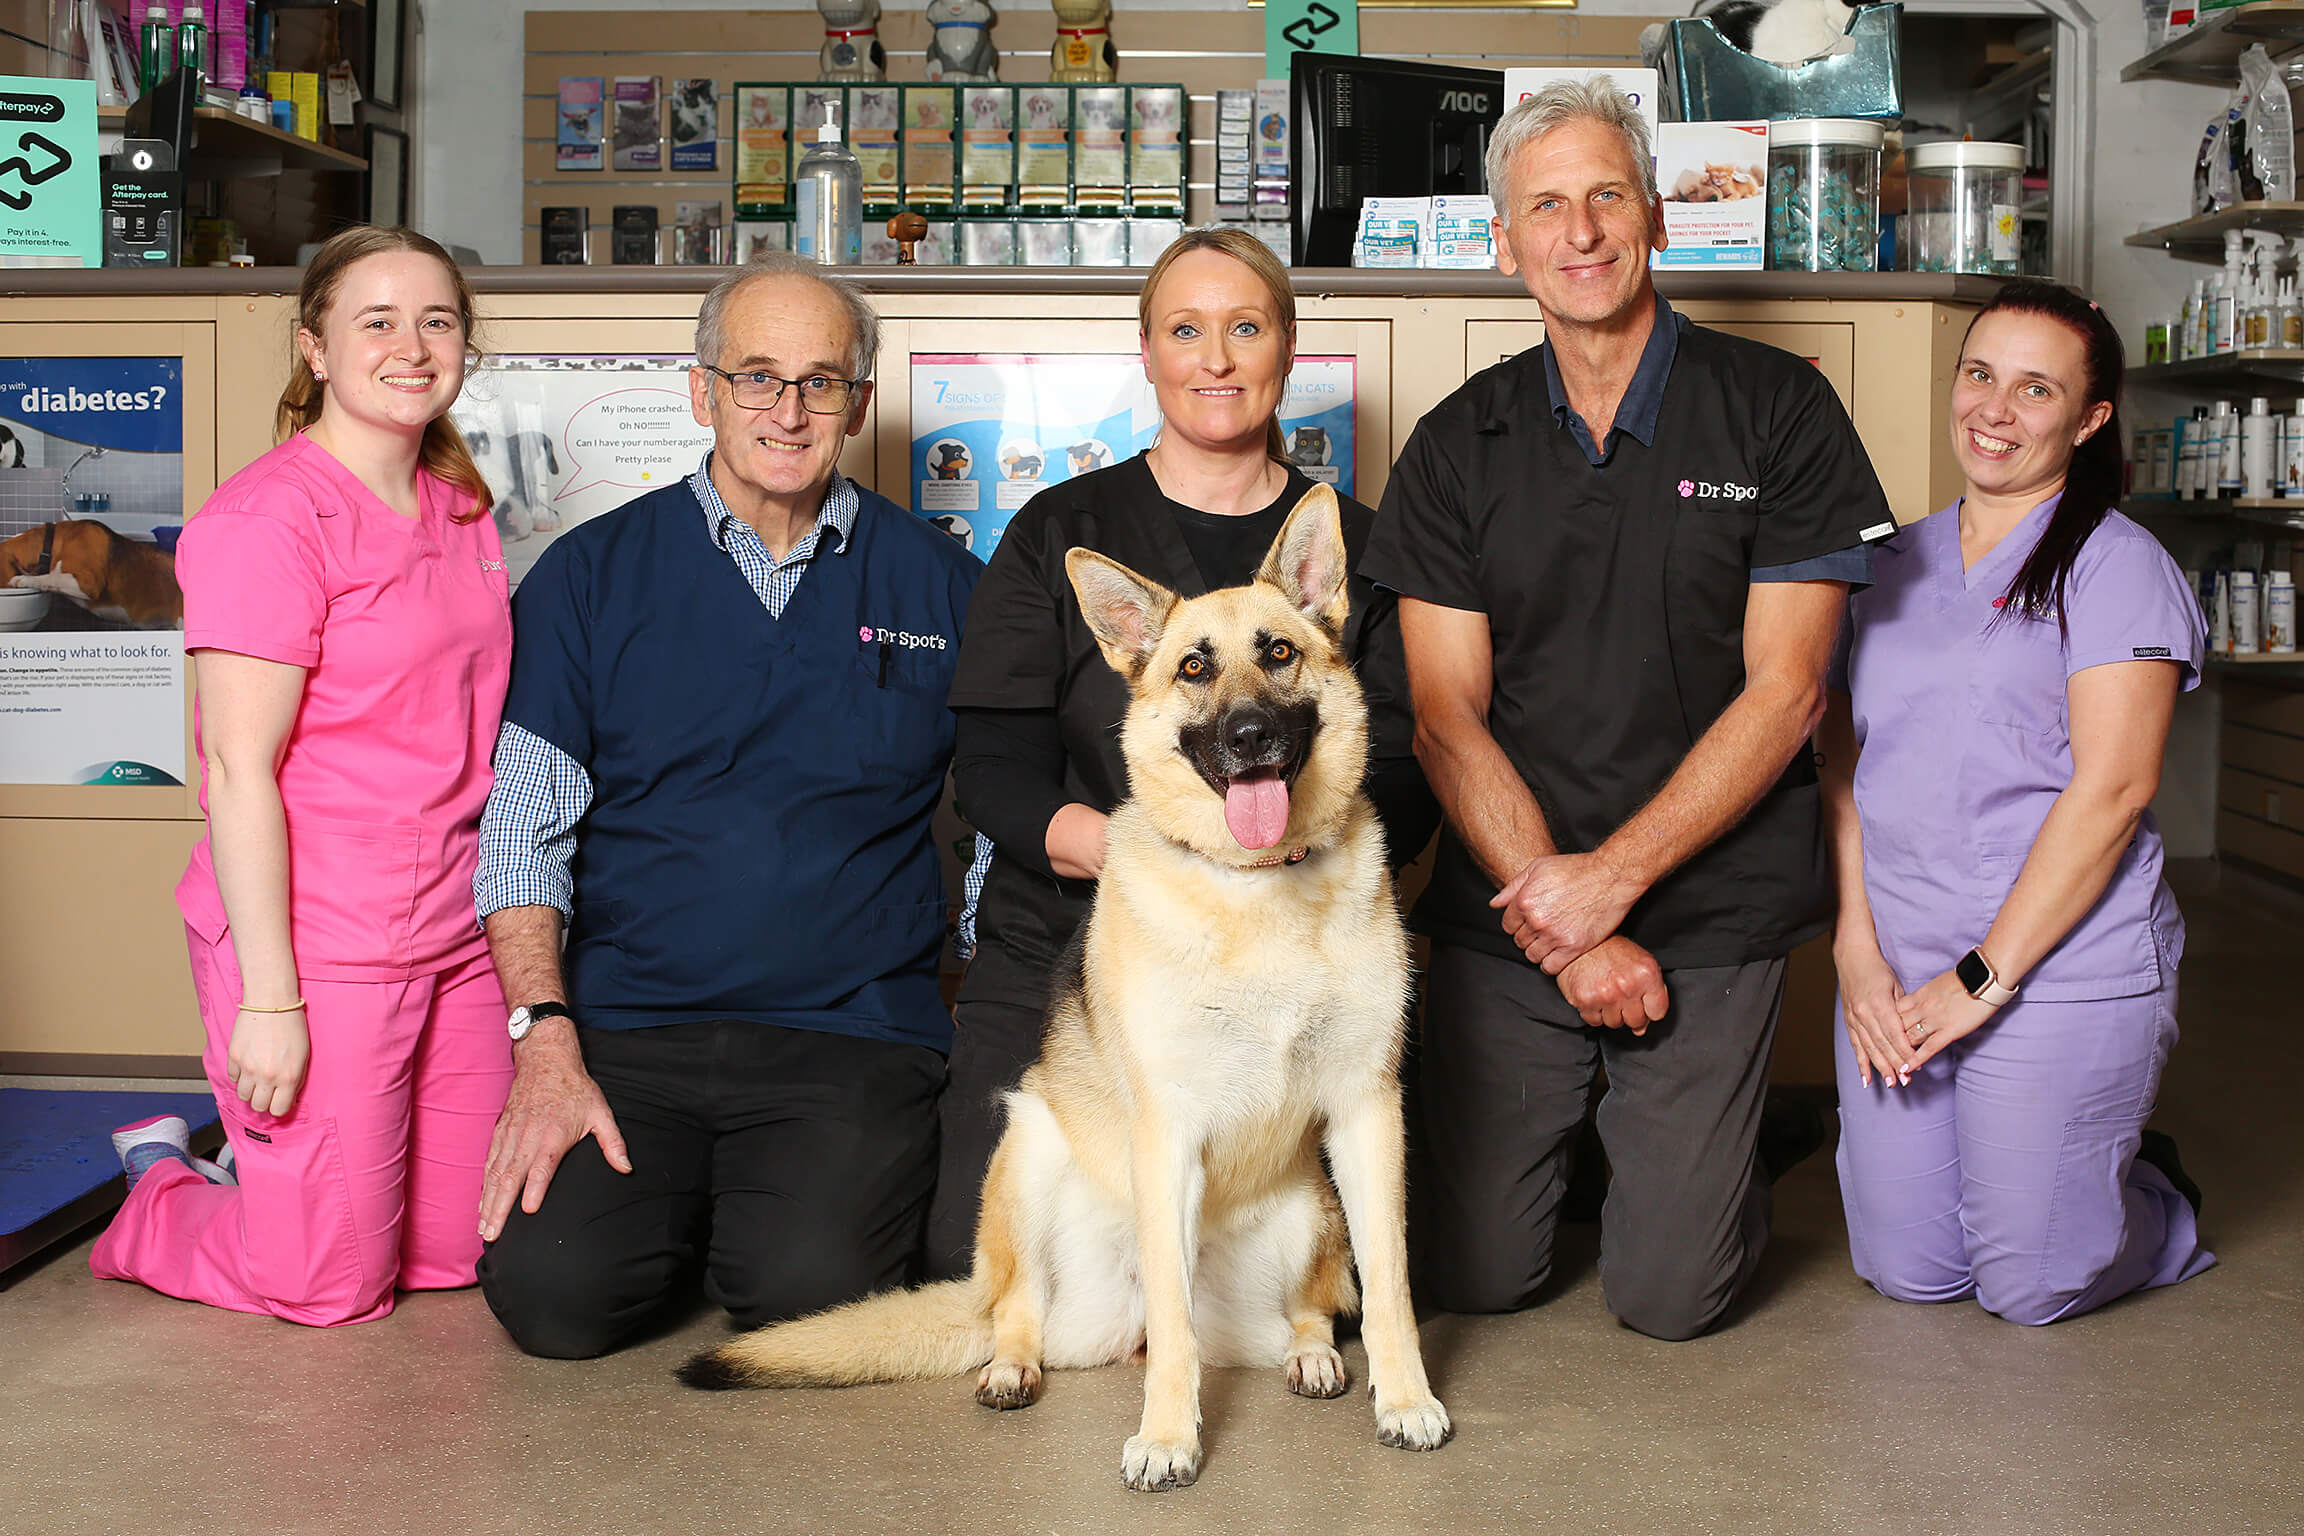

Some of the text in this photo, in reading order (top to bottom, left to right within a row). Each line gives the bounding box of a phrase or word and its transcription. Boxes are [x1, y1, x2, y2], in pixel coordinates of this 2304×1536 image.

[0, 101, 41, 114] fterpay
[1440, 91, 1488, 114] AOC
[112, 191, 169, 200] Afterpay card.
[7, 228, 24, 237] Pay
[18, 238, 71, 247] interest-free.
[8, 381, 27, 390] with
[1305, 383, 1336, 393] CATS
[21, 386, 167, 413] diabetes?
[945, 393, 982, 404] SIGNS
[601, 405, 615, 416] My
[616, 404, 647, 414] iPhone
[619, 421, 632, 431] Oh
[576, 438, 592, 448] Can
[599, 438, 620, 447] have
[621, 439, 641, 449] your
[615, 455, 672, 464] Pretty please
[1697, 481, 1721, 499] Dr
[876, 627, 947, 650] Dr Spot's
[11, 646, 66, 661] knowing
[70, 646, 100, 658] what
[104, 648, 118, 658] to
[121, 645, 148, 658] look
[151, 644, 171, 658] for.
[0, 706, 62, 714] .cat-dog-diabetes.com
